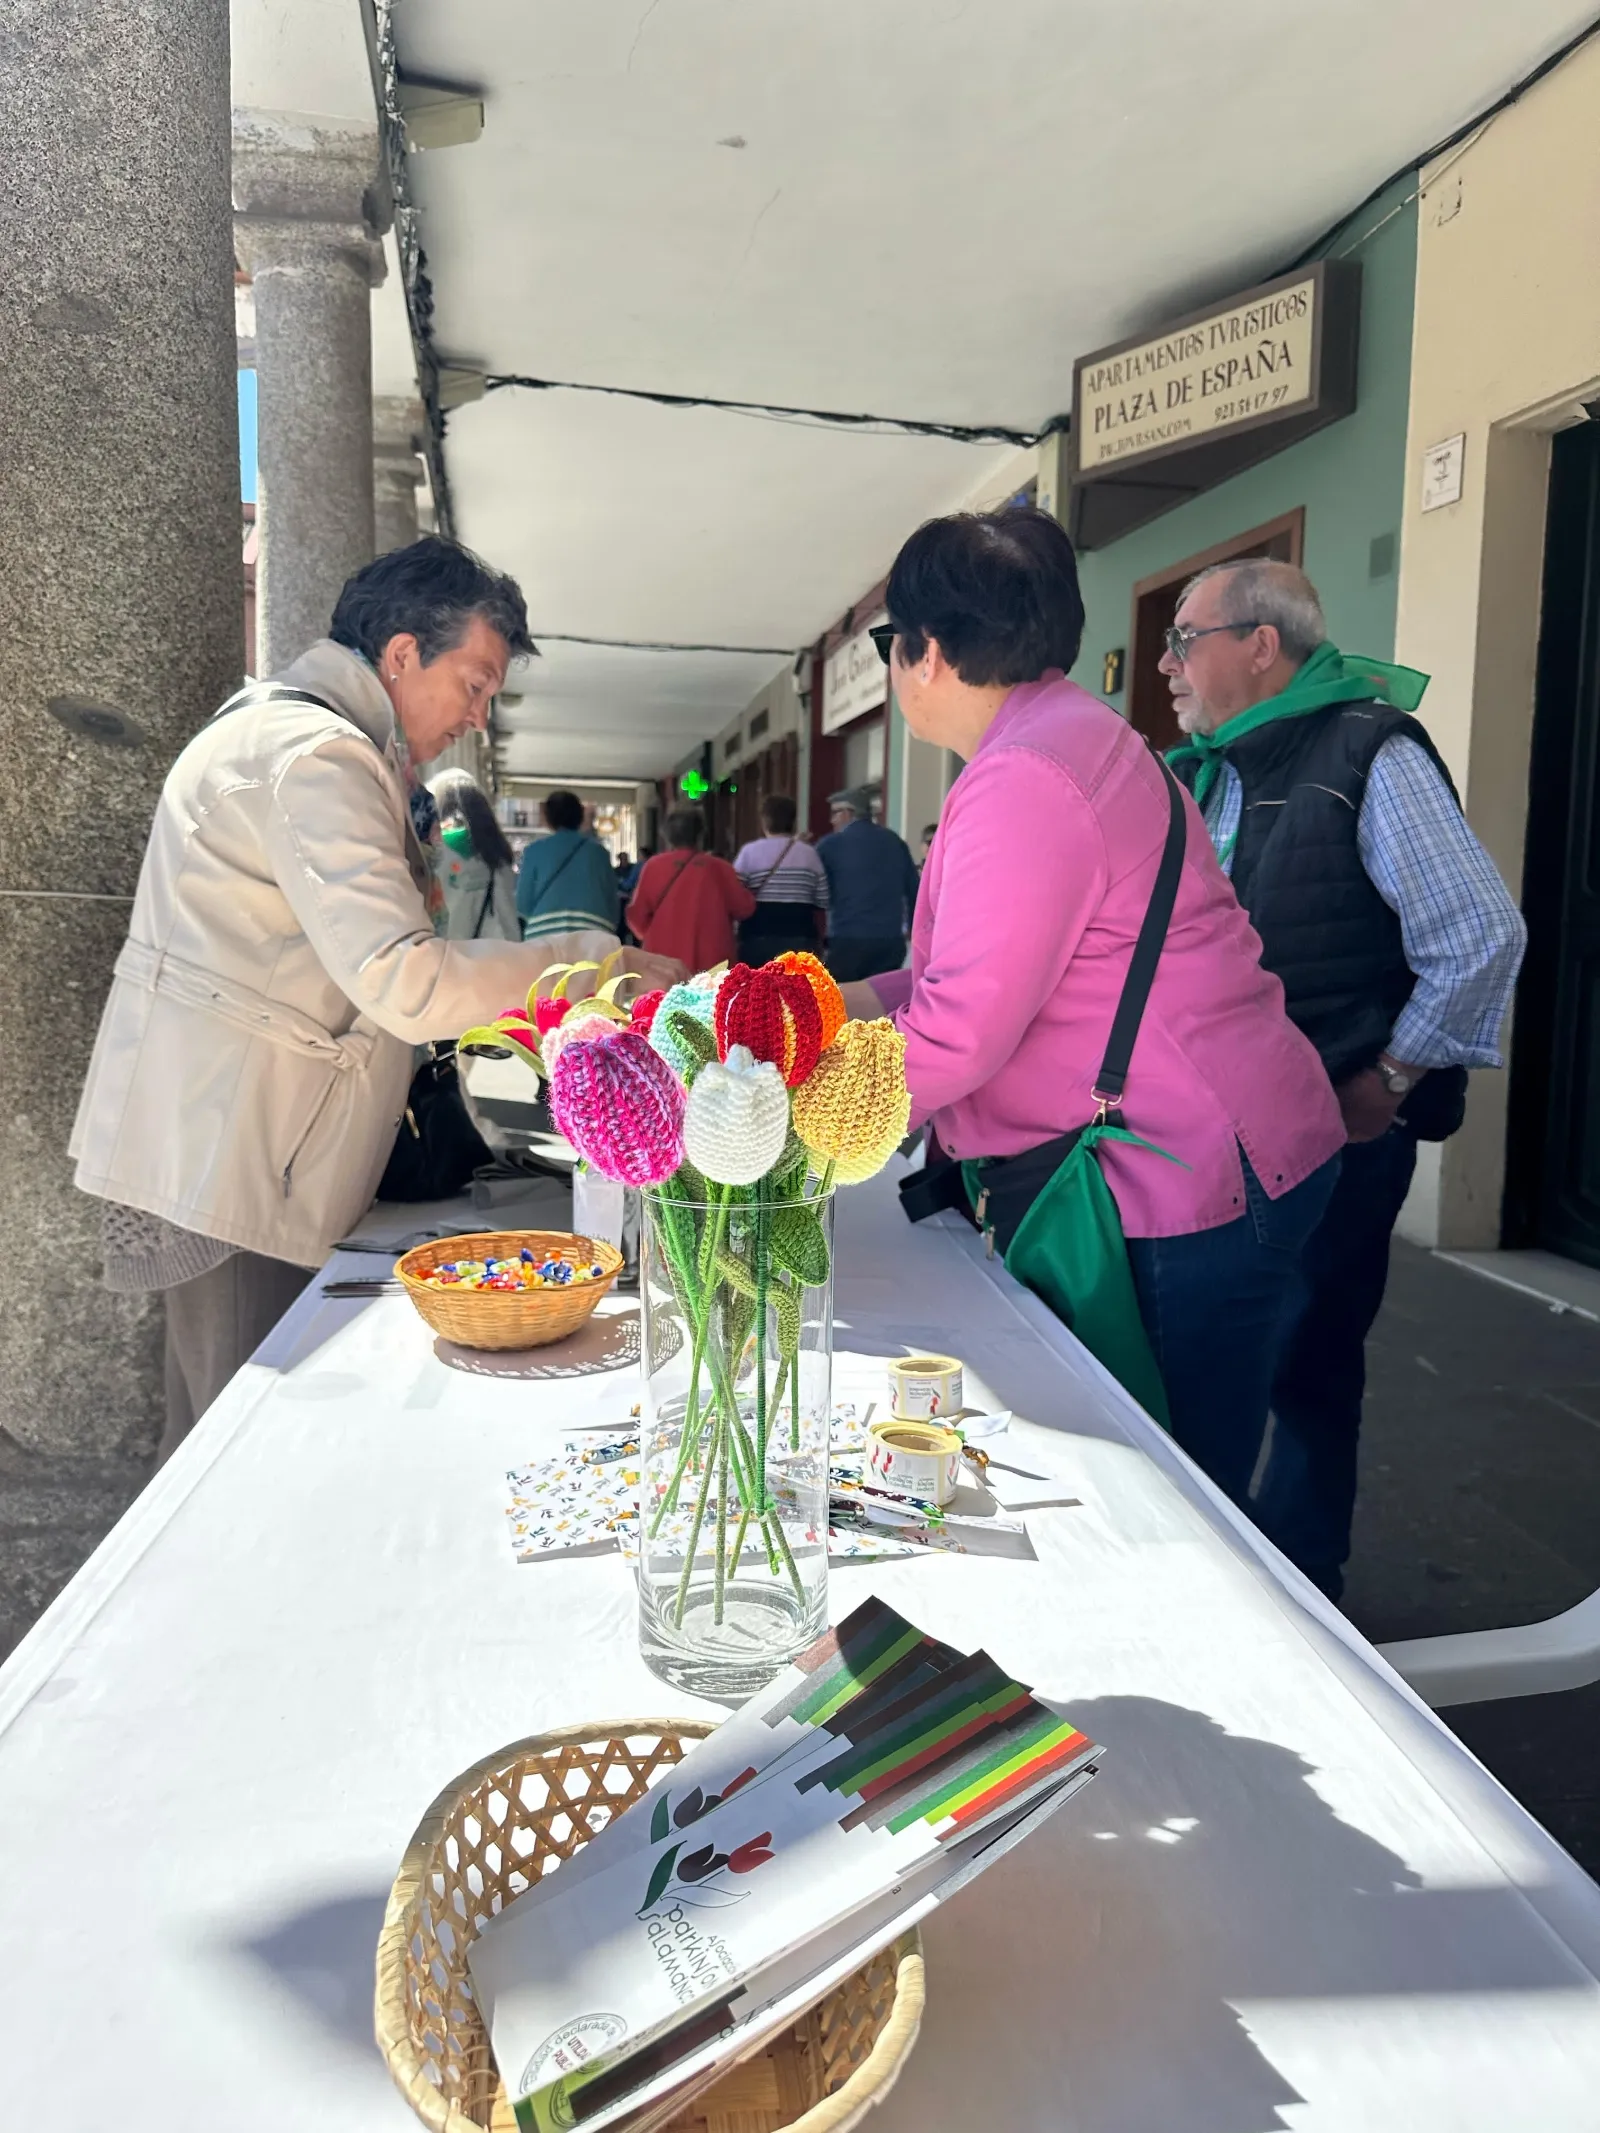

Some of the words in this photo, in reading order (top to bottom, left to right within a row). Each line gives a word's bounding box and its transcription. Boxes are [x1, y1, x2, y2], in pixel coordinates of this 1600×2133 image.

[1087, 331, 1204, 395] APARTAMENTOS
[1095, 389, 1158, 434] PLAZA
[1166, 374, 1194, 409] DE
[1201, 339, 1293, 398] ESPAÑA
